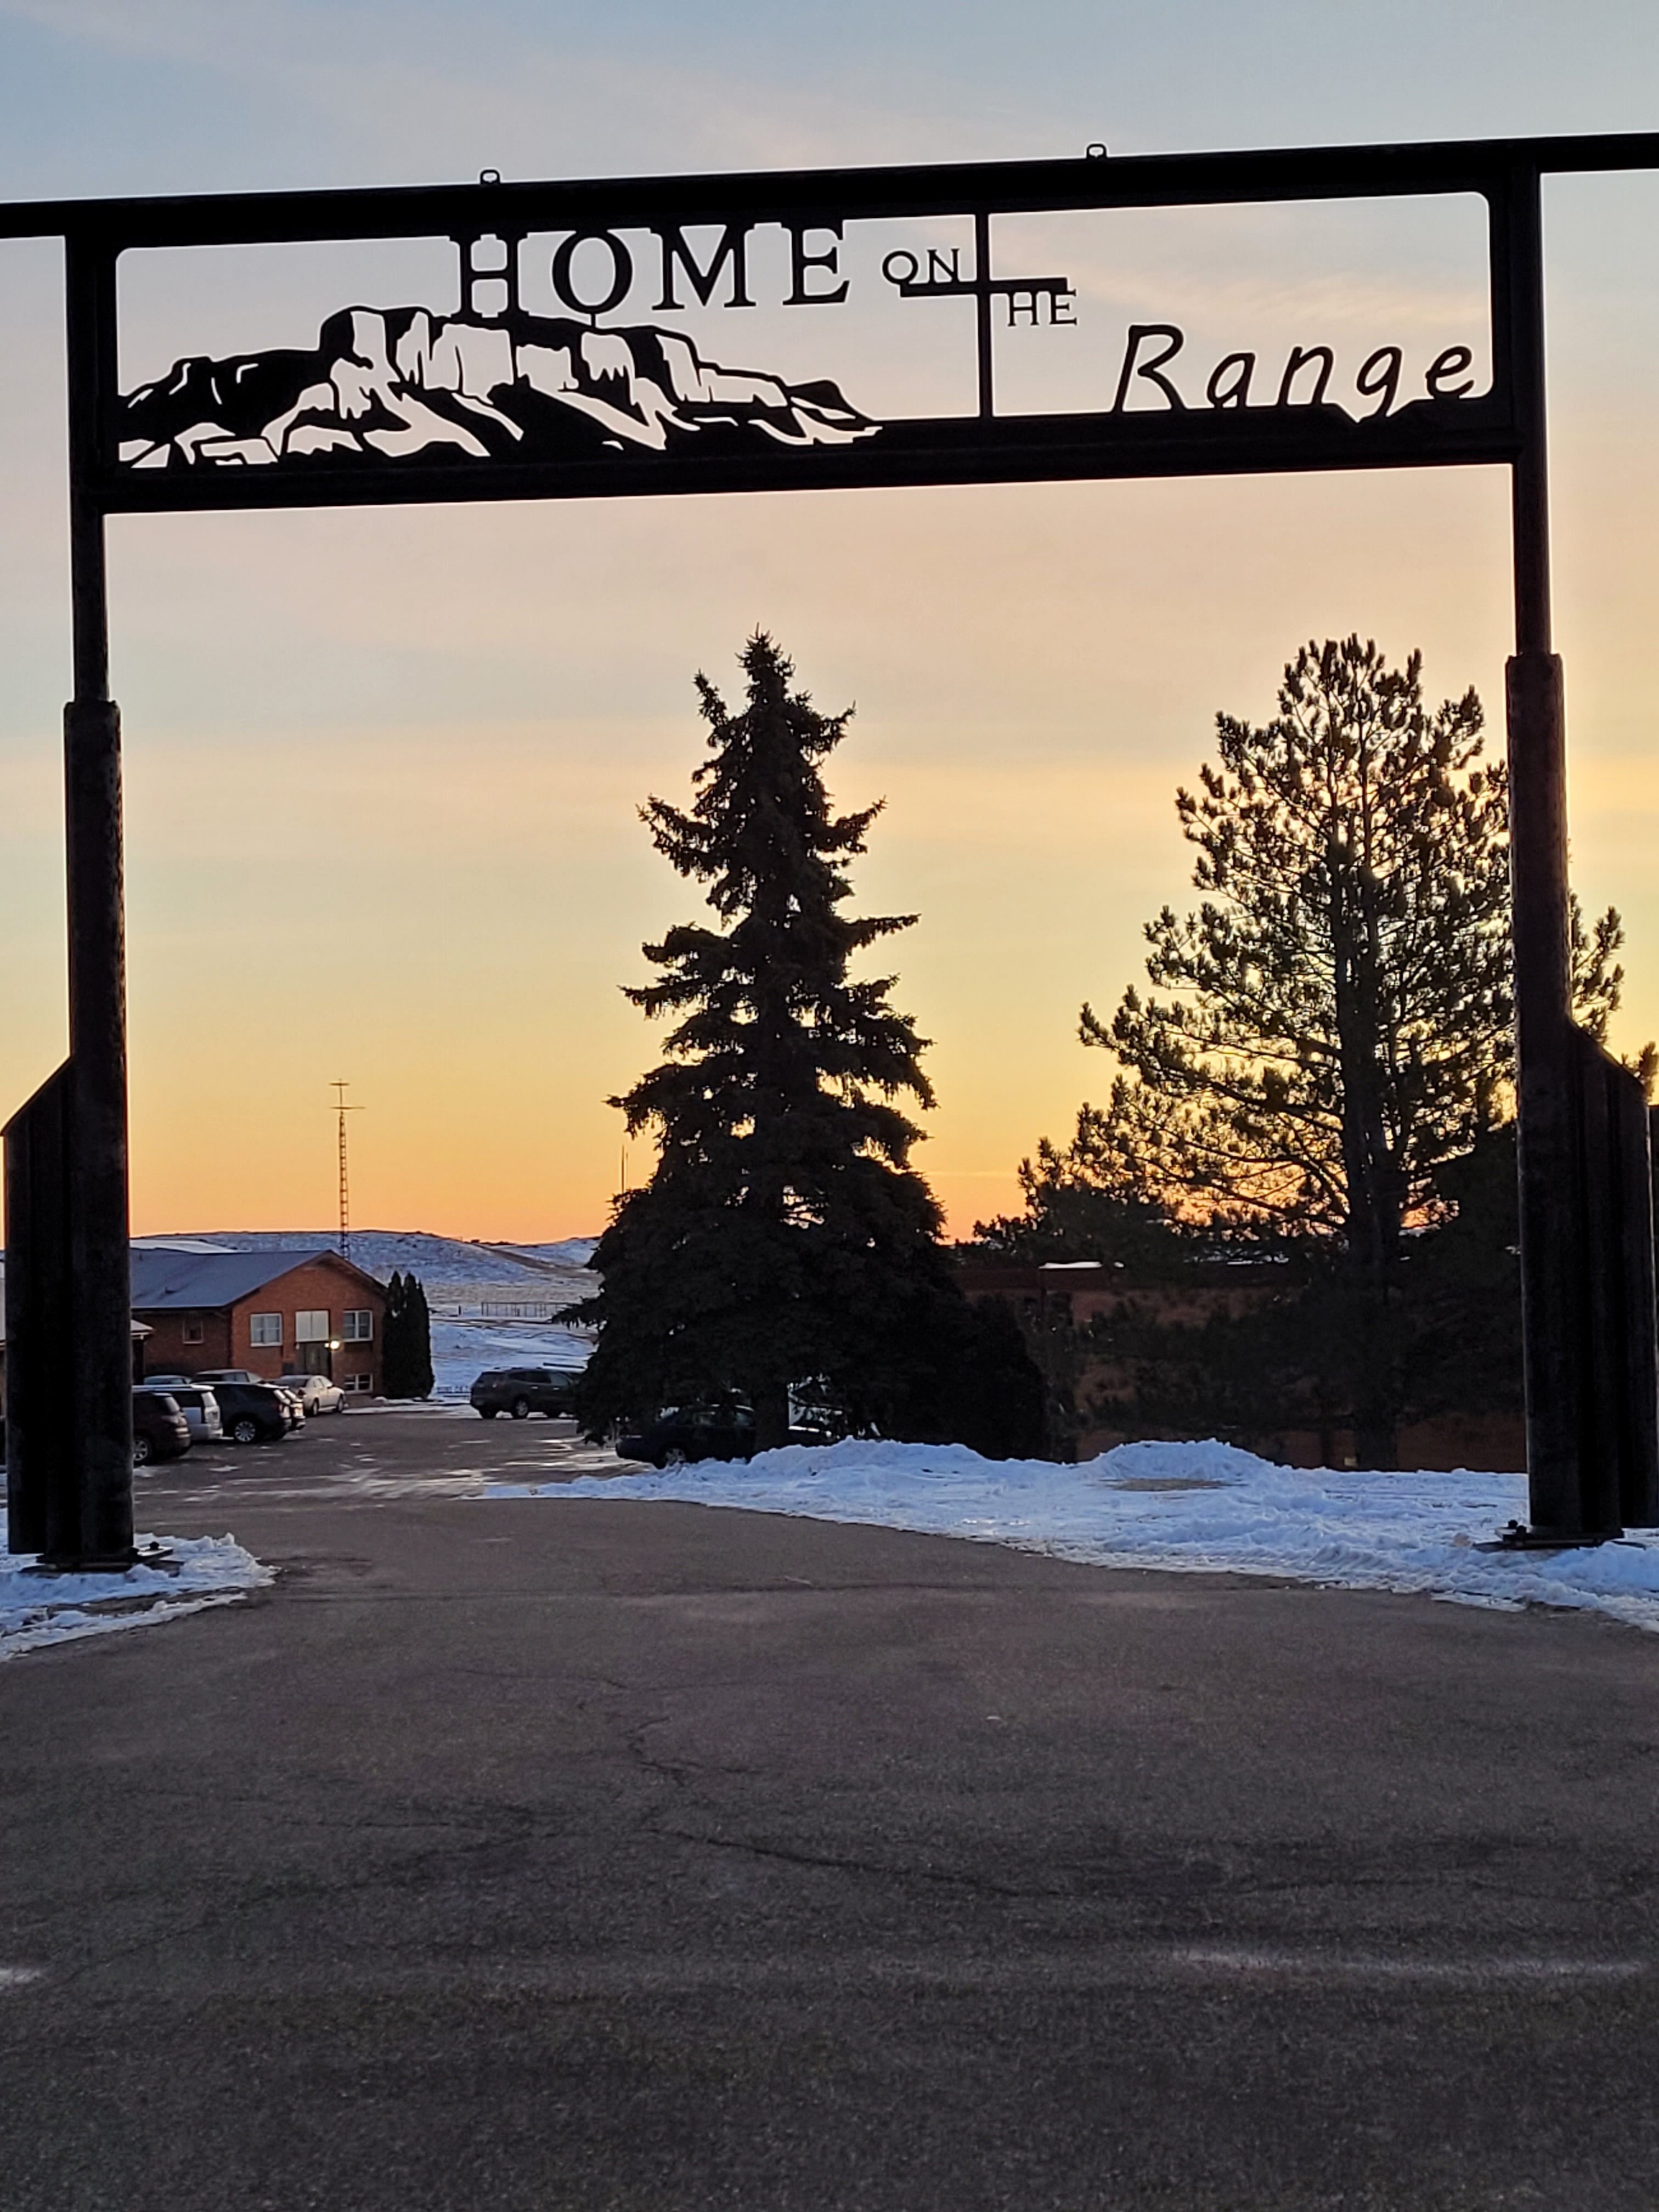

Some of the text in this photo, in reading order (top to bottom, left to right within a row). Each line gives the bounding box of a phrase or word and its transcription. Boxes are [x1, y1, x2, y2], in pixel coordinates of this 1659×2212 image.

[451, 221, 960, 317] HOME ON
[1111, 324, 1475, 422] Range
